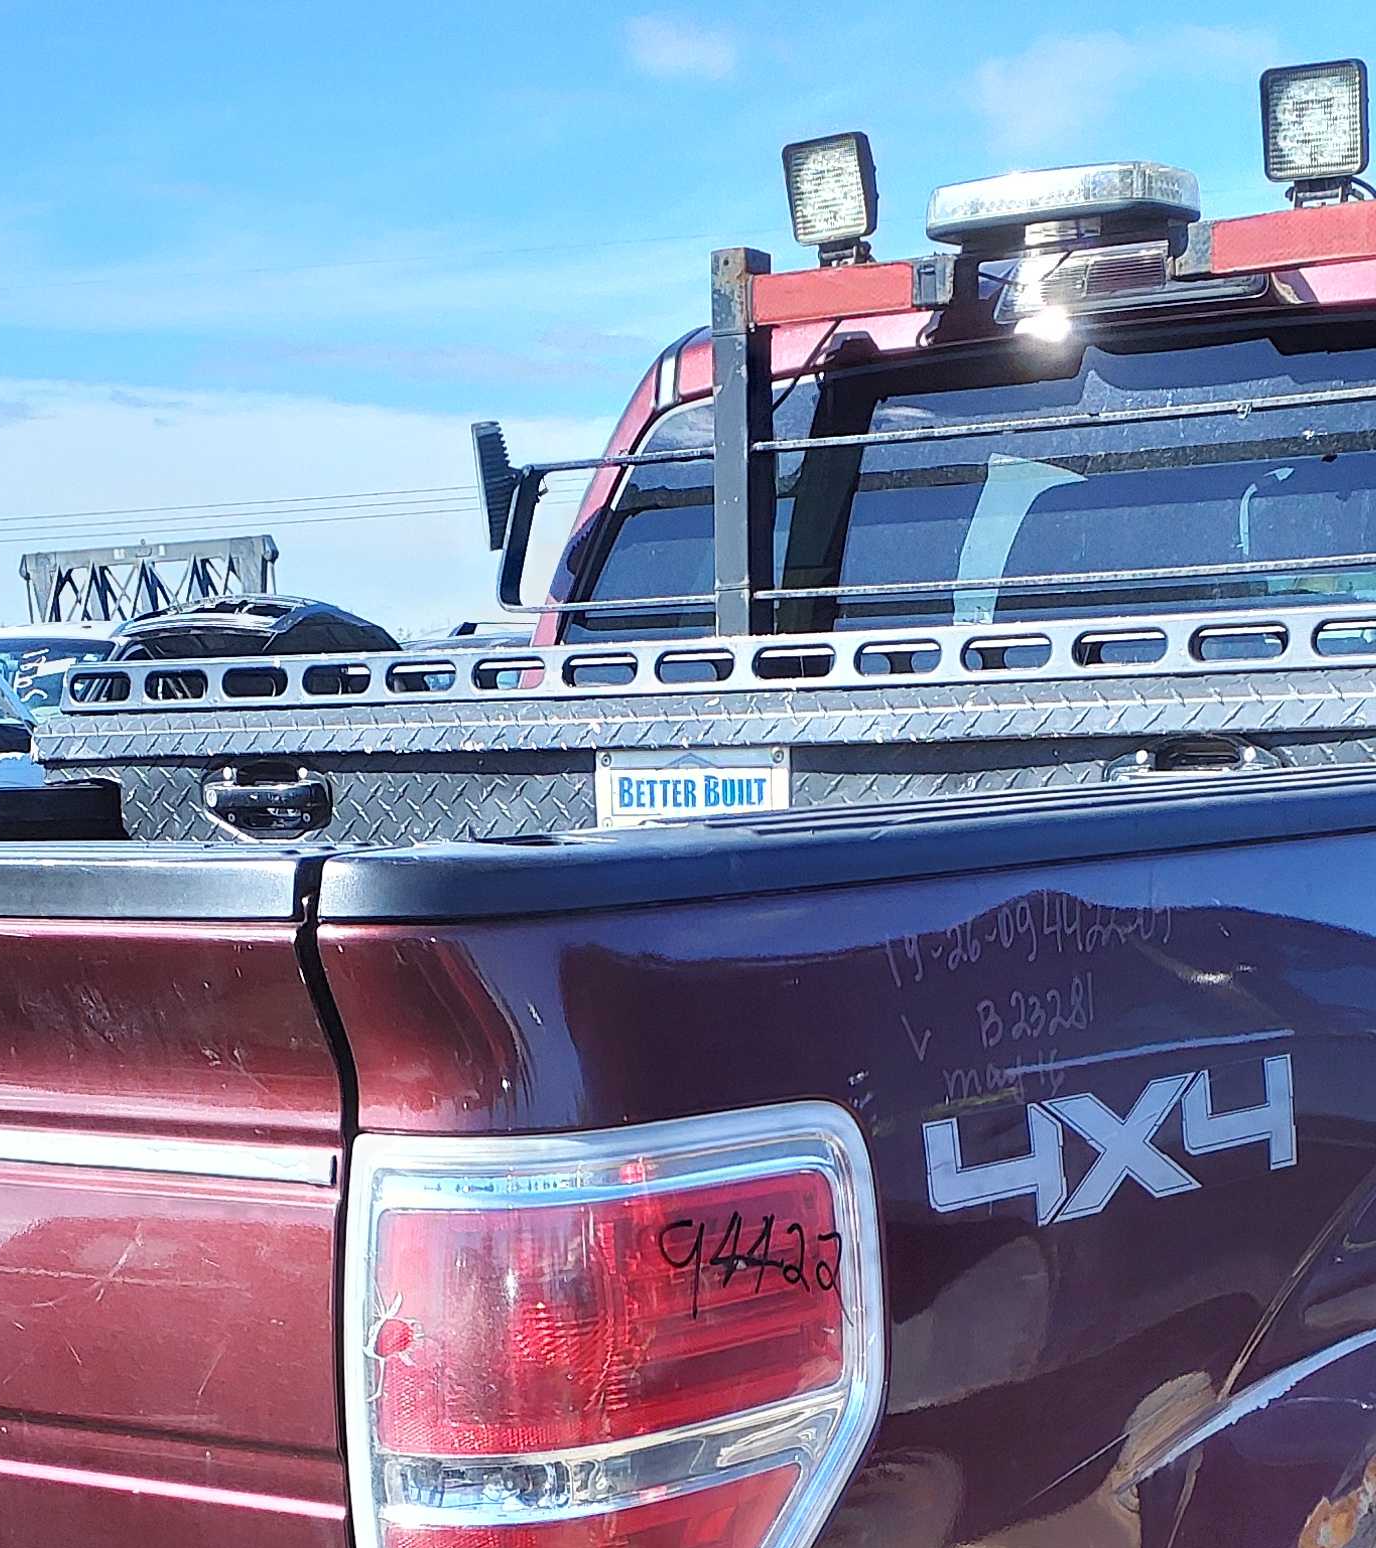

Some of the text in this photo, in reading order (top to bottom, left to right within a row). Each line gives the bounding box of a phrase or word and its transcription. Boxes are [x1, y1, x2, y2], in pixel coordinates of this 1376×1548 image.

[618, 775, 767, 809] BETTER BUILT
[975, 971, 1095, 1049] B23281
[657, 1211, 855, 1326] 94422
